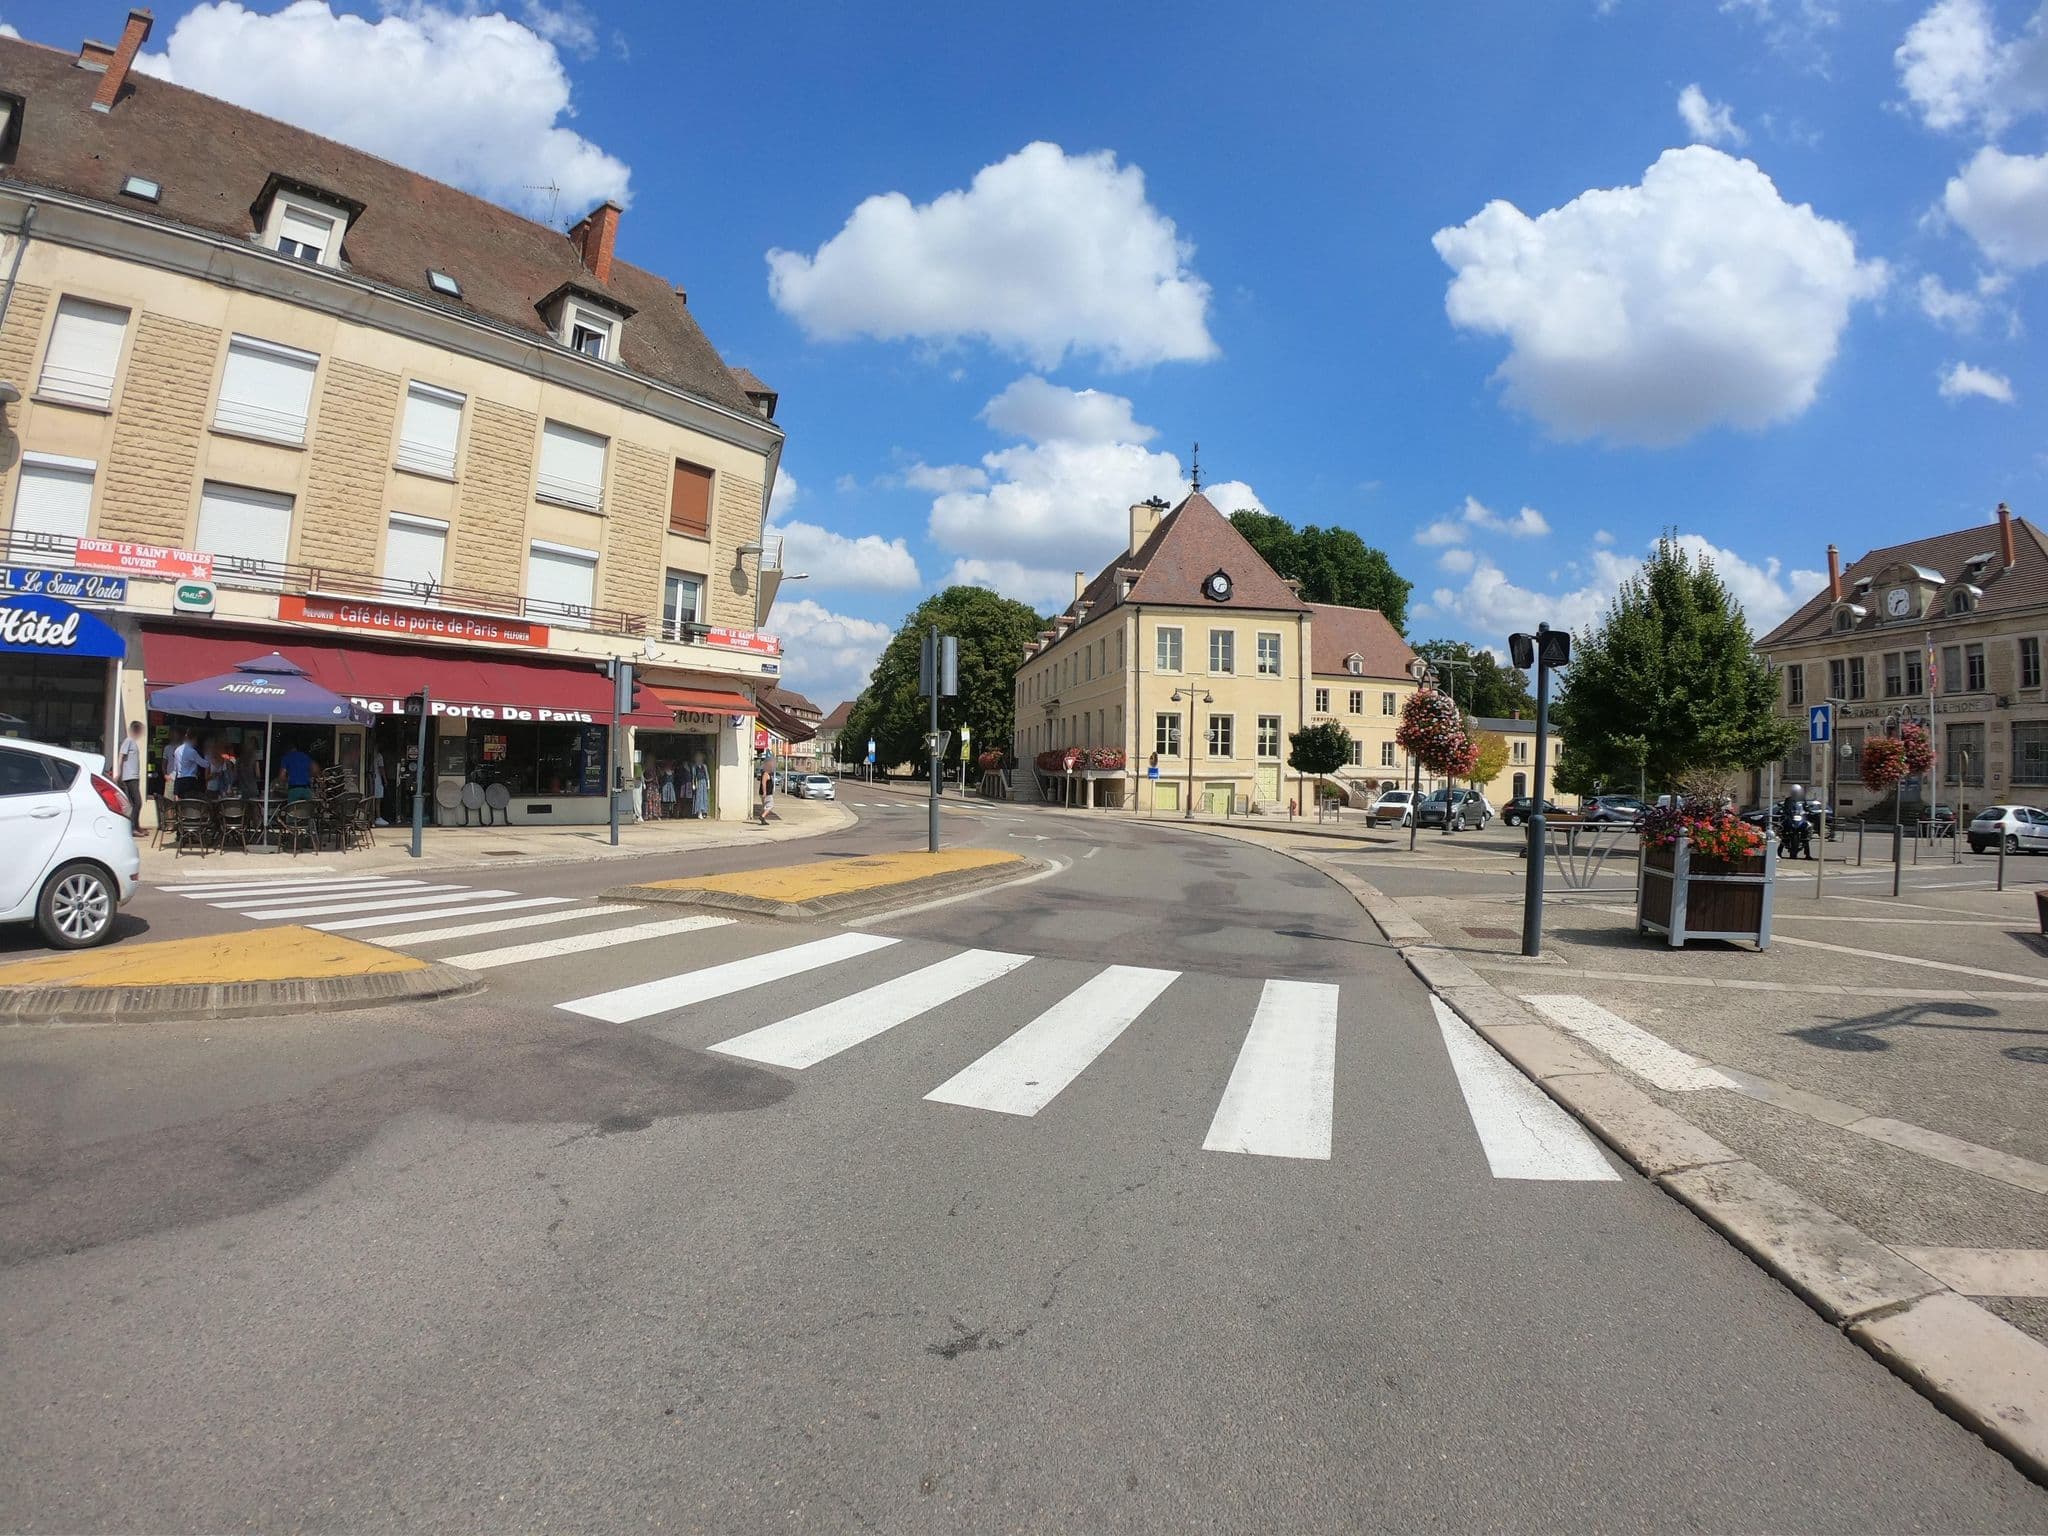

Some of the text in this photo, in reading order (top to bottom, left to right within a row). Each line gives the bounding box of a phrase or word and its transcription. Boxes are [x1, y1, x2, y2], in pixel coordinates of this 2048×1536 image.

[80, 540, 212, 564] HOTEL LE SAINT VORLES
[121, 557, 158, 568] OUVERT
[21, 570, 43, 593] Le
[46, 573, 86, 596] Saint
[86, 576, 123, 600] Vorles
[0, 606, 80, 646] Hôtel
[340, 605, 498, 638] Café de la porte de Paris
[218, 683, 286, 695] Affligem
[431, 702, 495, 719] Porte
[502, 706, 532, 721] De
[538, 709, 593, 723] Paris
